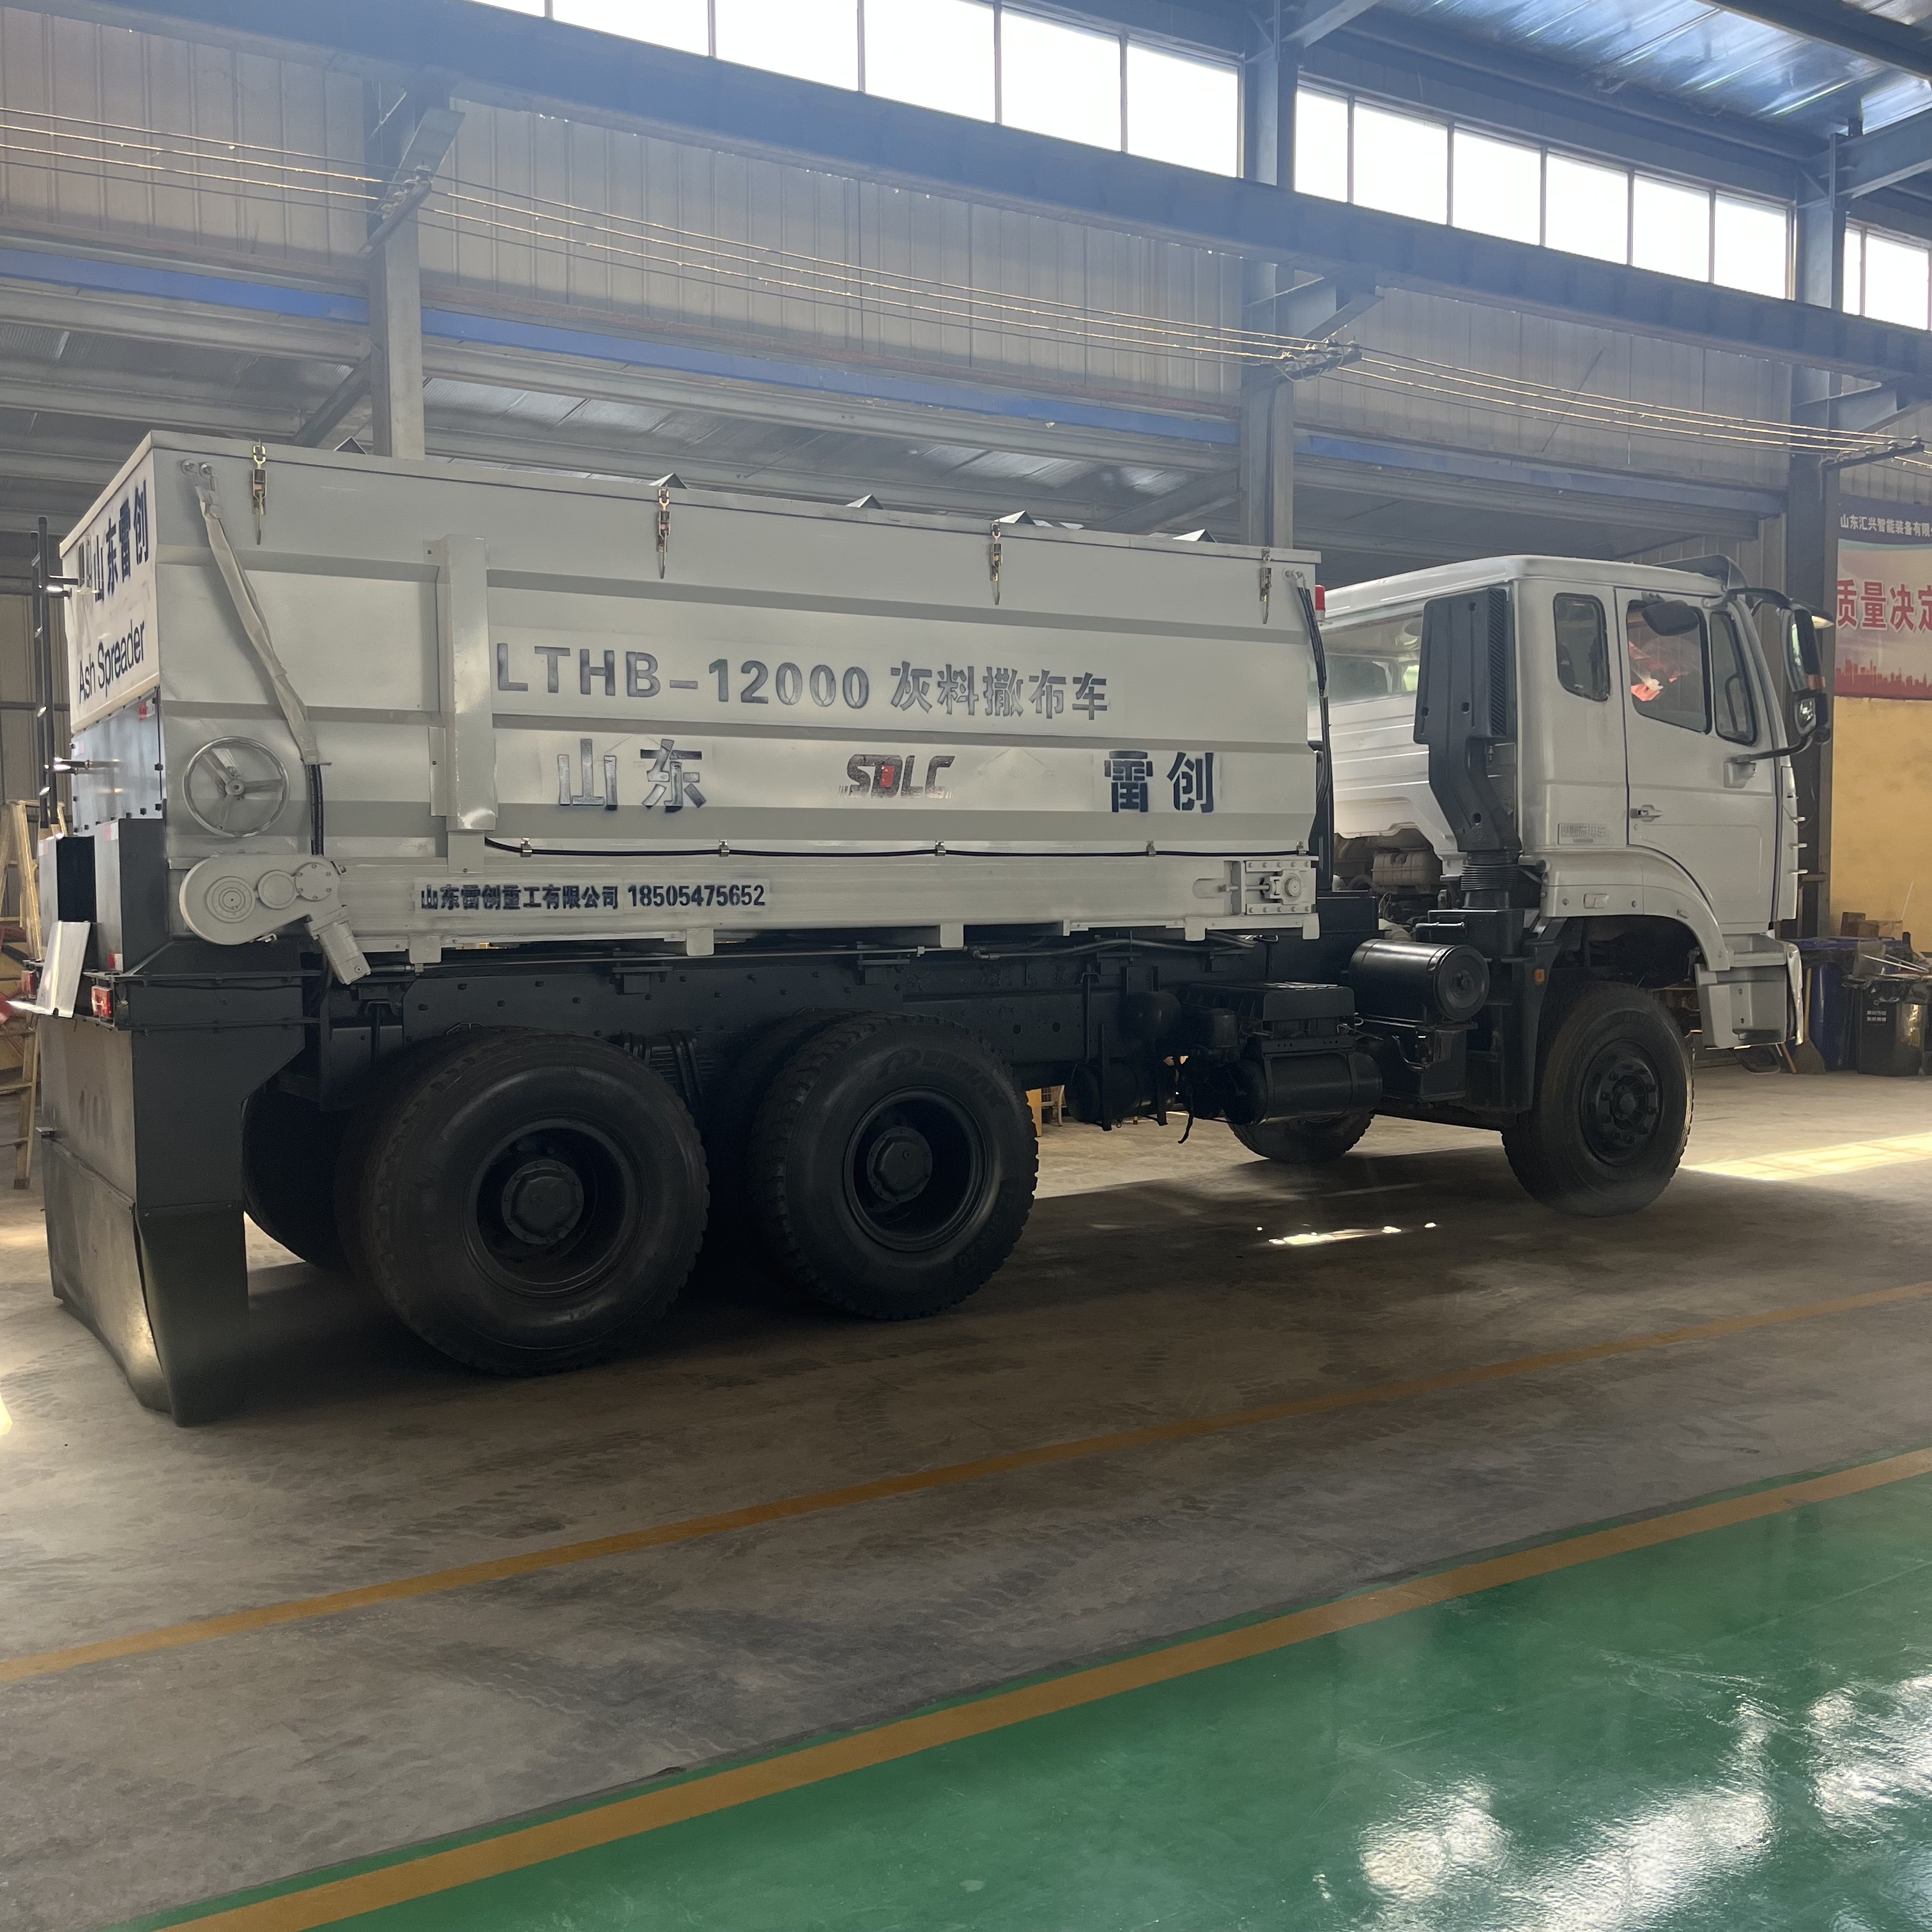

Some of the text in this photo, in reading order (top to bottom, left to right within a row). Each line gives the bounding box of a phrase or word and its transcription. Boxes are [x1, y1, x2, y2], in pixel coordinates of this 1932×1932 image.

[1840, 514, 1932, 537] 山东汇兴智能装备有限
[79, 618, 145, 705] Ash Spreader
[496, 643, 1108, 721] LTHB-12000 灰料撒布车
[558, 739, 706, 812] 山东
[1104, 750, 1215, 813] 雷创
[420, 884, 765, 910] 山东雷创重工有限公司 18505475652
